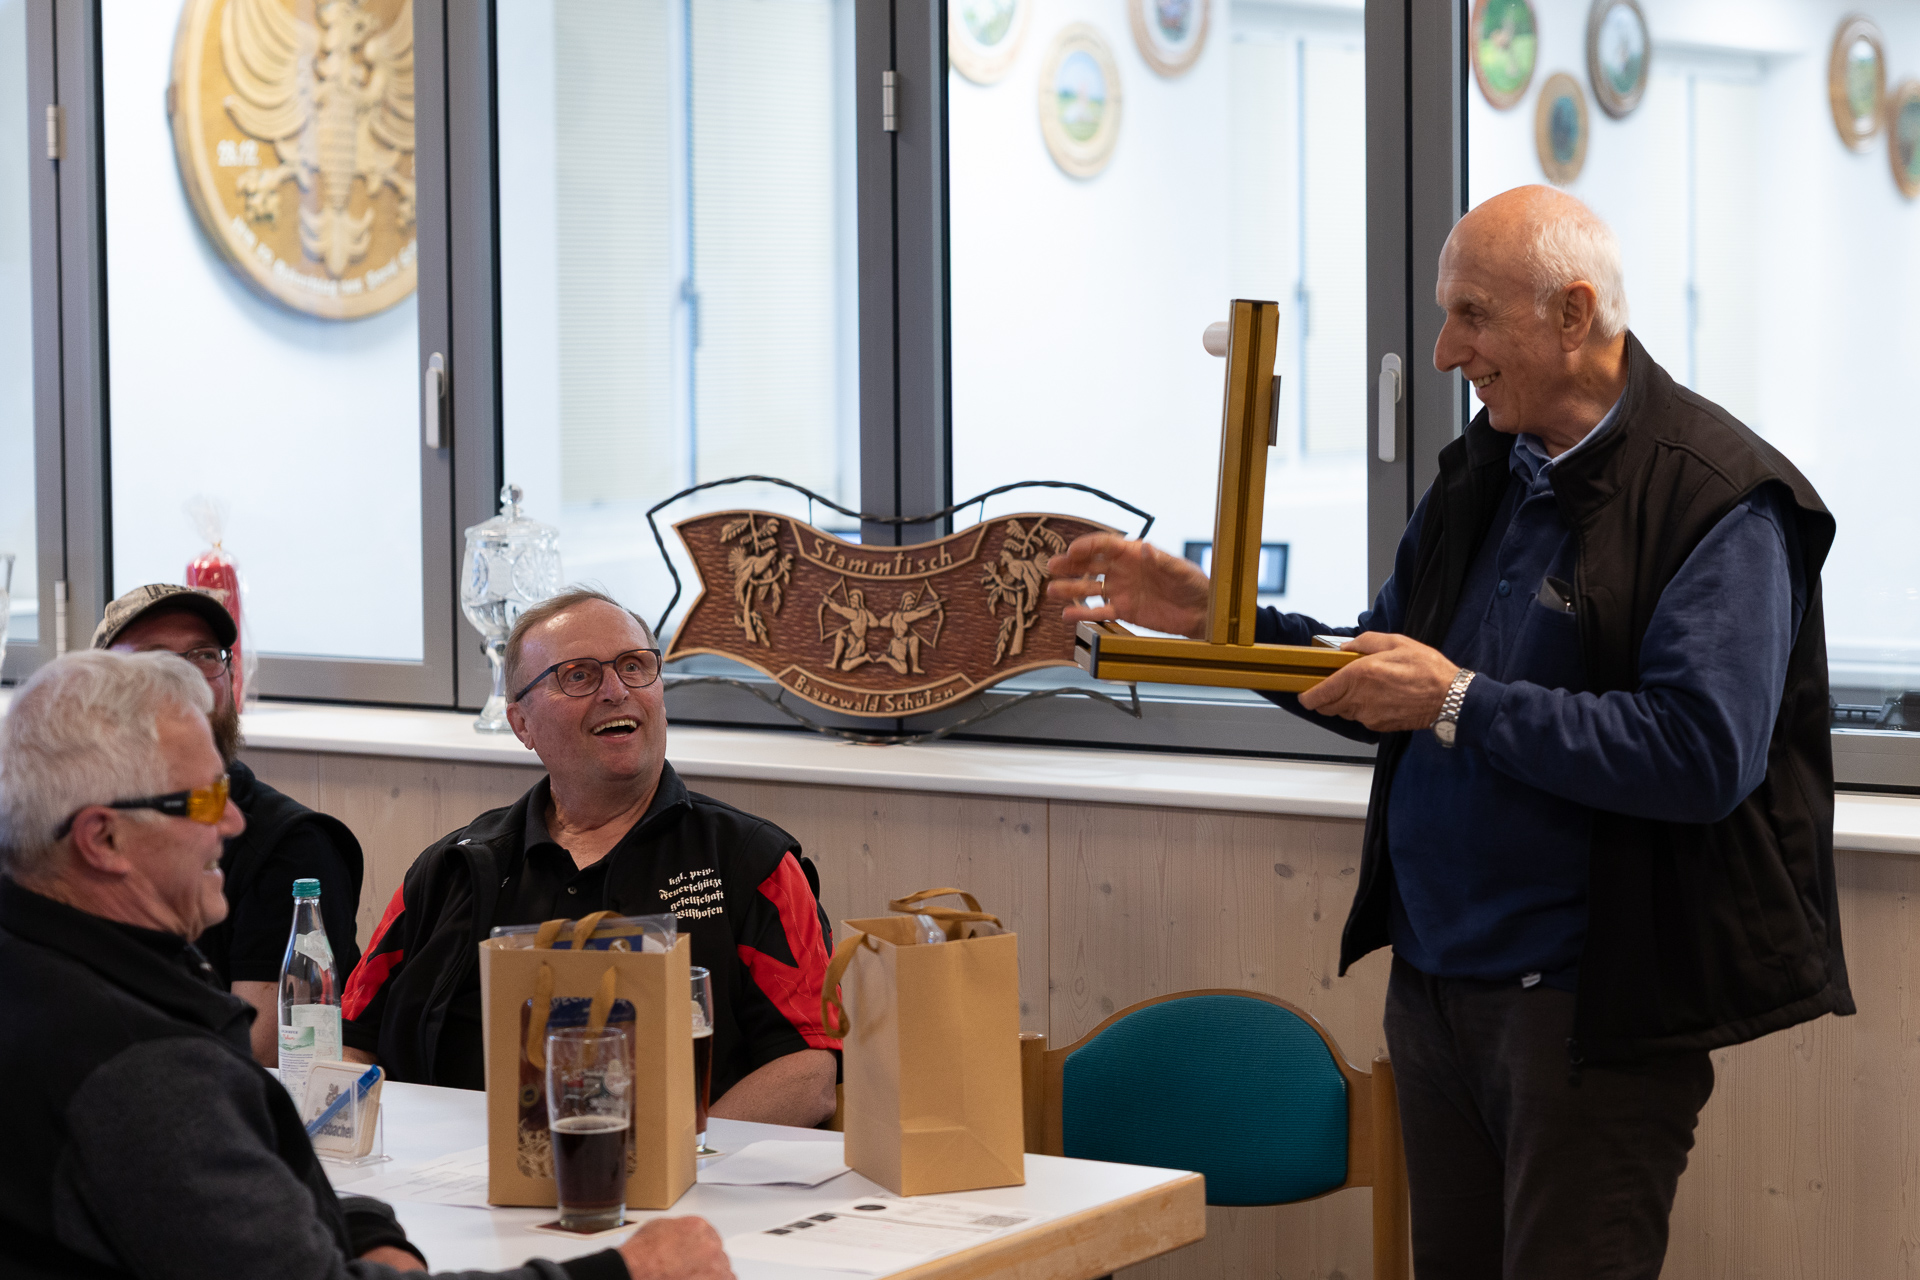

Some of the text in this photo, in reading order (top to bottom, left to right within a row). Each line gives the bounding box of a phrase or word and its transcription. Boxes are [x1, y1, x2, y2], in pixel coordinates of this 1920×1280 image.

[811, 538, 953, 576] Stammtisch
[794, 675, 880, 712] Bayerwald
[668, 867, 715, 886] kgl. priv.
